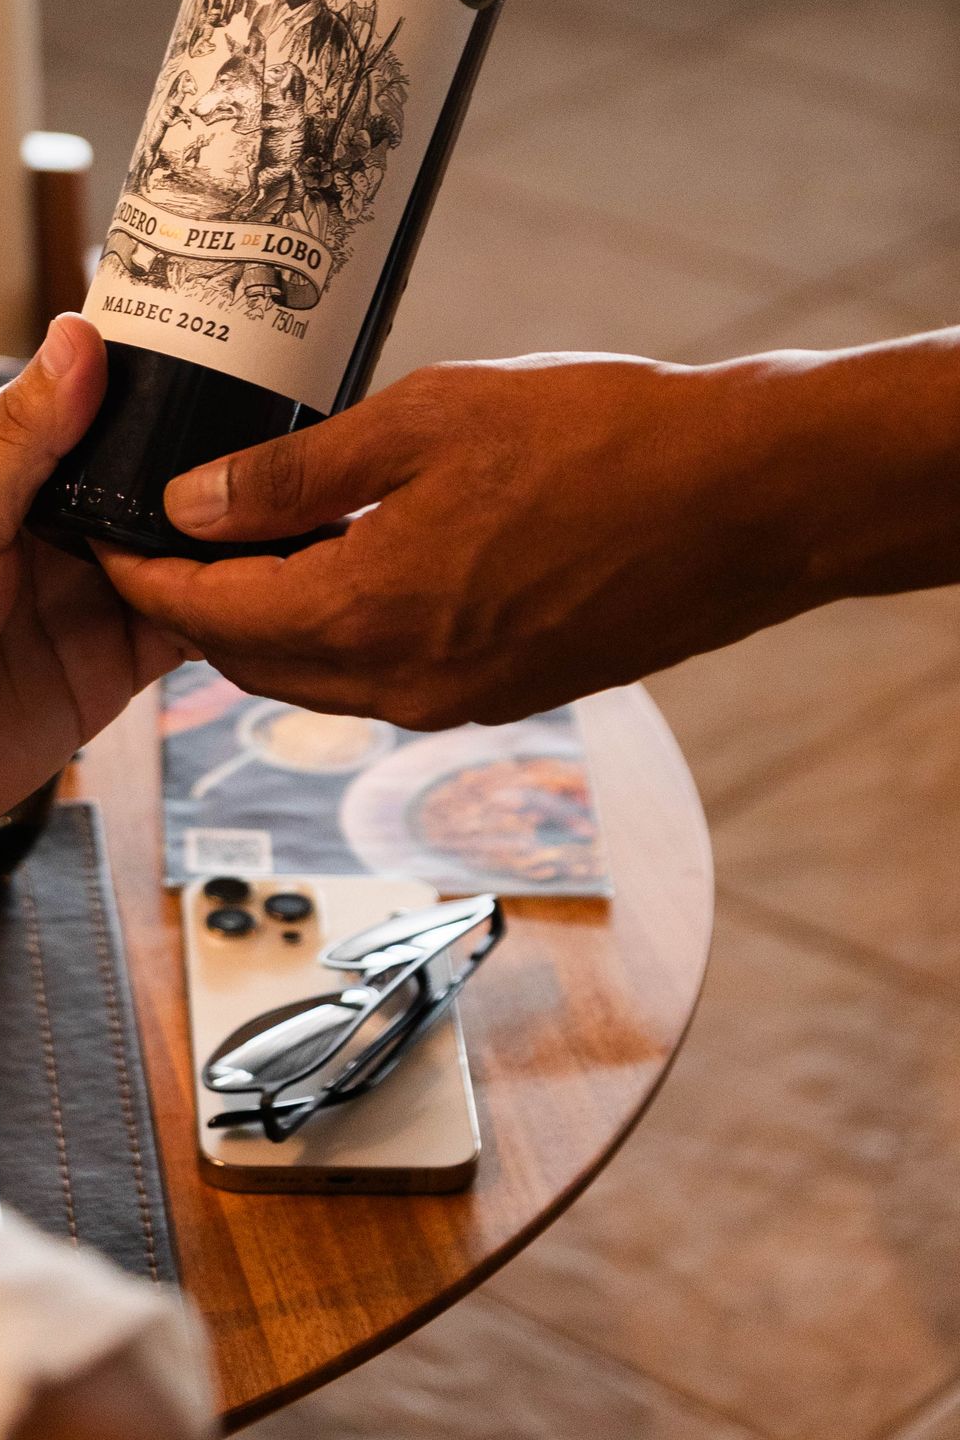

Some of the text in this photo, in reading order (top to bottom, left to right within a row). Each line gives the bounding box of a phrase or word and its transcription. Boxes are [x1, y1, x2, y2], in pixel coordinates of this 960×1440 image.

[184, 228, 236, 251] PIEL
[241, 233, 262, 246] DE
[261, 233, 322, 270] LOBO
[101, 295, 231, 343] MALBEC 2022
